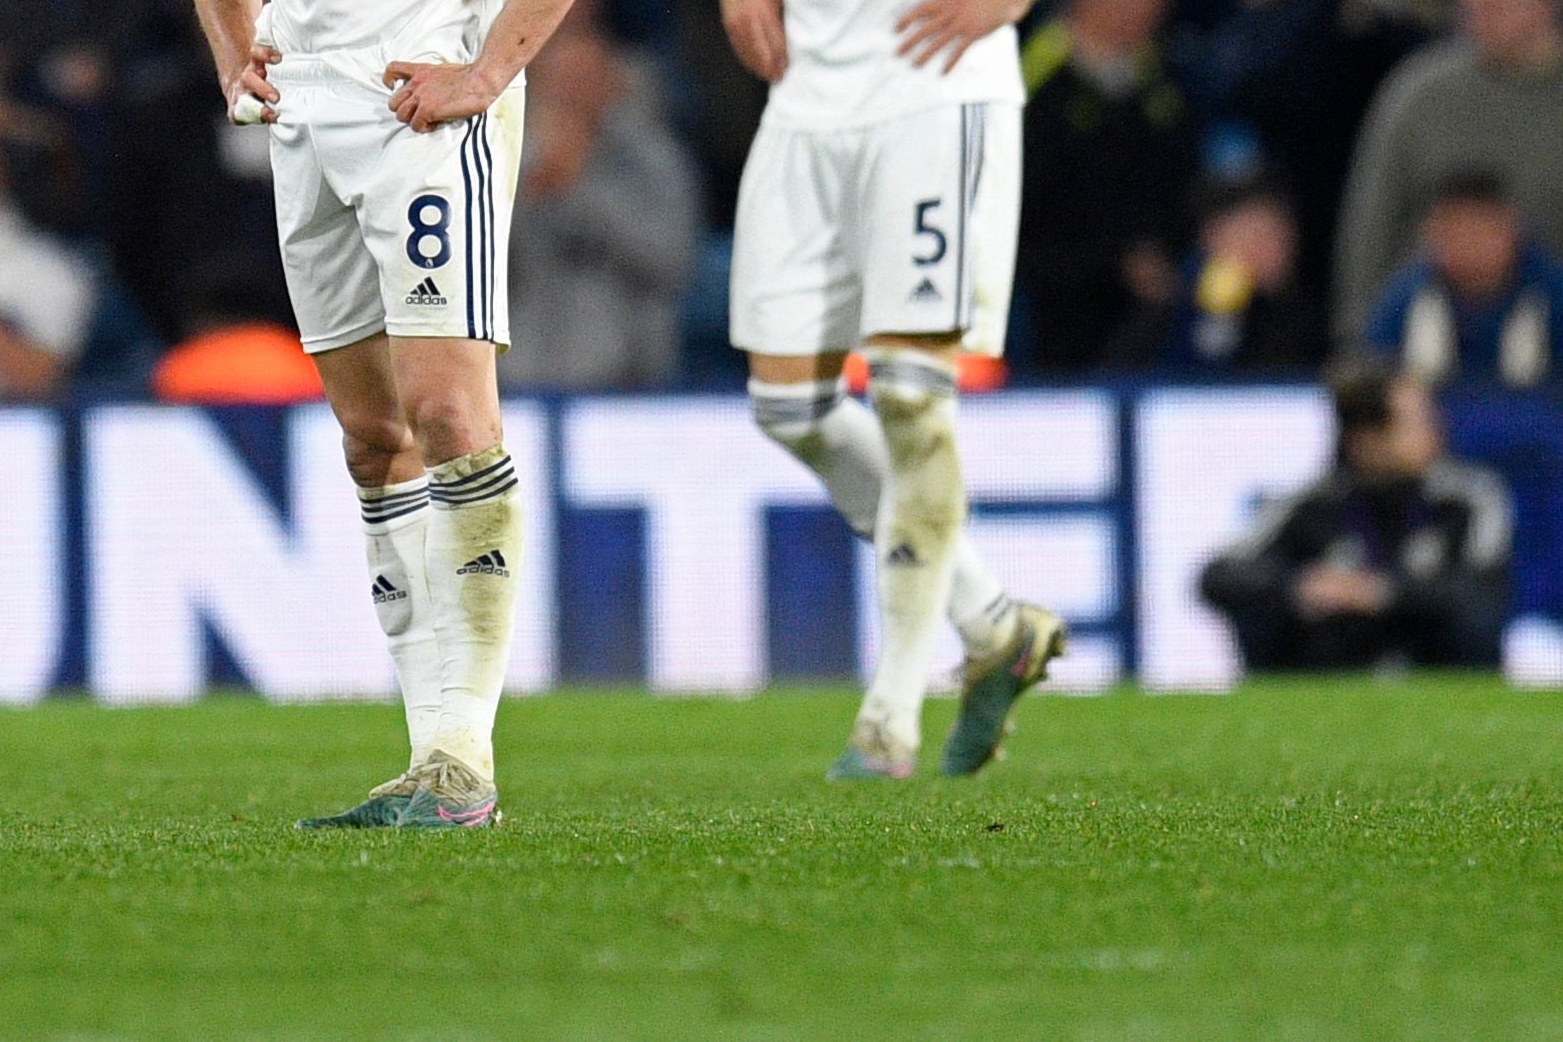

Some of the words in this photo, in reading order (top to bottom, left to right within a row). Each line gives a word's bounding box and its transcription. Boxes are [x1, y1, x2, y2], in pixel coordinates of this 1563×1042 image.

[406, 194, 453, 270] 8
[912, 198, 947, 266] 5
[405, 294, 448, 306] adidas
[456, 564, 510, 577] adidas
